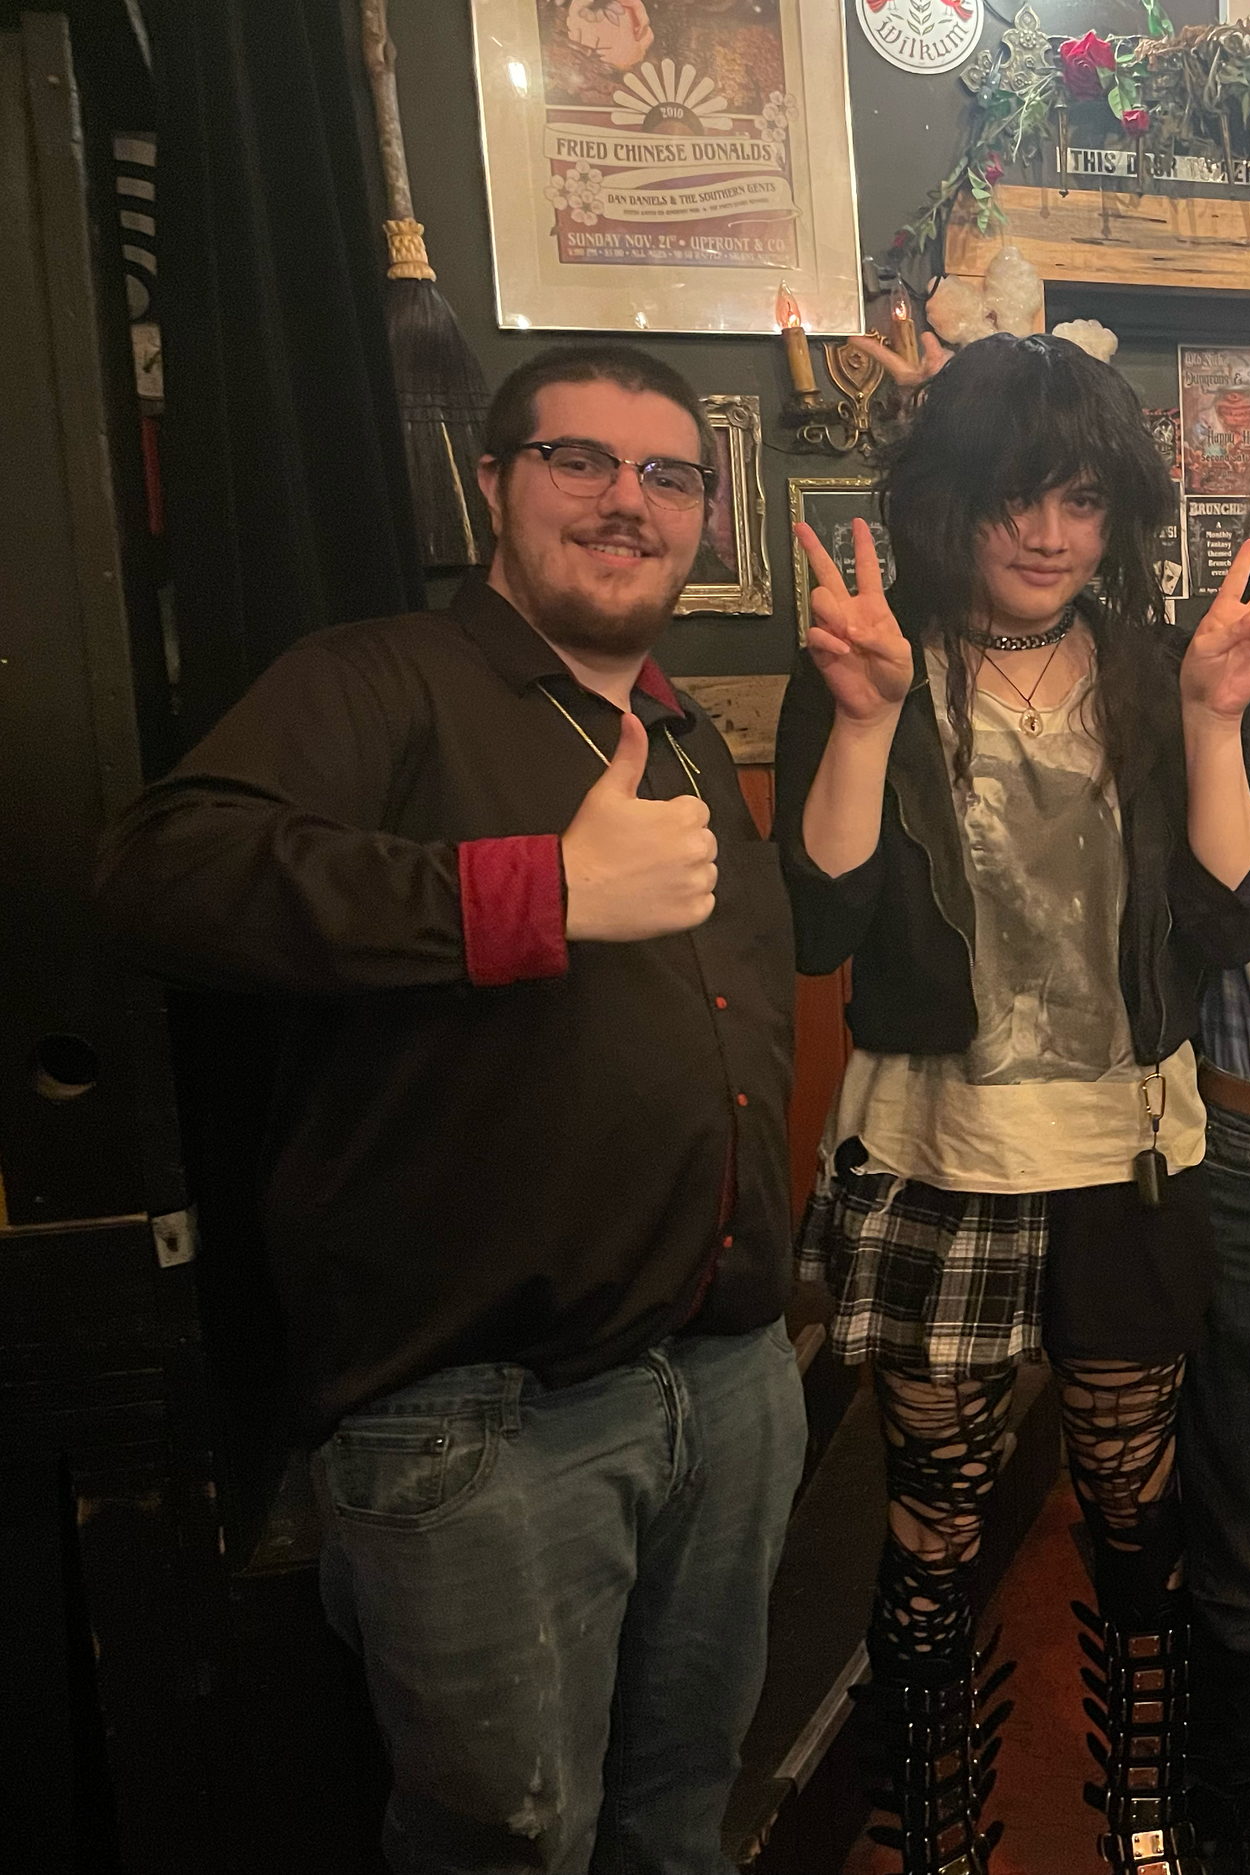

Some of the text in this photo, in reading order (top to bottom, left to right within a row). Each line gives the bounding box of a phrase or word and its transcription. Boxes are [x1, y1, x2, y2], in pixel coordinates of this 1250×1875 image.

[662, 106, 684, 119] 2010
[556, 137, 772, 162] FRIED CHINESE DONALDS
[1070, 149, 1117, 174] THIS
[1127, 152, 1177, 178] DOR
[607, 193, 628, 205] DAN
[628, 195, 668, 206] DANIELS
[670, 195, 677, 205] &
[678, 193, 698, 205] THE
[698, 185, 746, 203] SOUTHERN
[746, 182, 776, 194] GENTS
[567, 232, 620, 248] SUNDAY
[625, 234, 656, 249] NOV.
[690, 235, 751, 251] UPFRONT
[754, 238, 763, 251] &
[1183, 370, 1229, 387] Dungeons
[1234, 372, 1242, 386] &
[1207, 429, 1235, 446] Happy
[1201, 453, 1230, 462] Second
[1189, 502, 1247, 516] BRUNCHE
[1215, 521, 1221, 529] A
[1205, 531, 1232, 540] Monthly
[1207, 541, 1231, 549] Fantasy
[1208, 559, 1232, 567] Brunch
